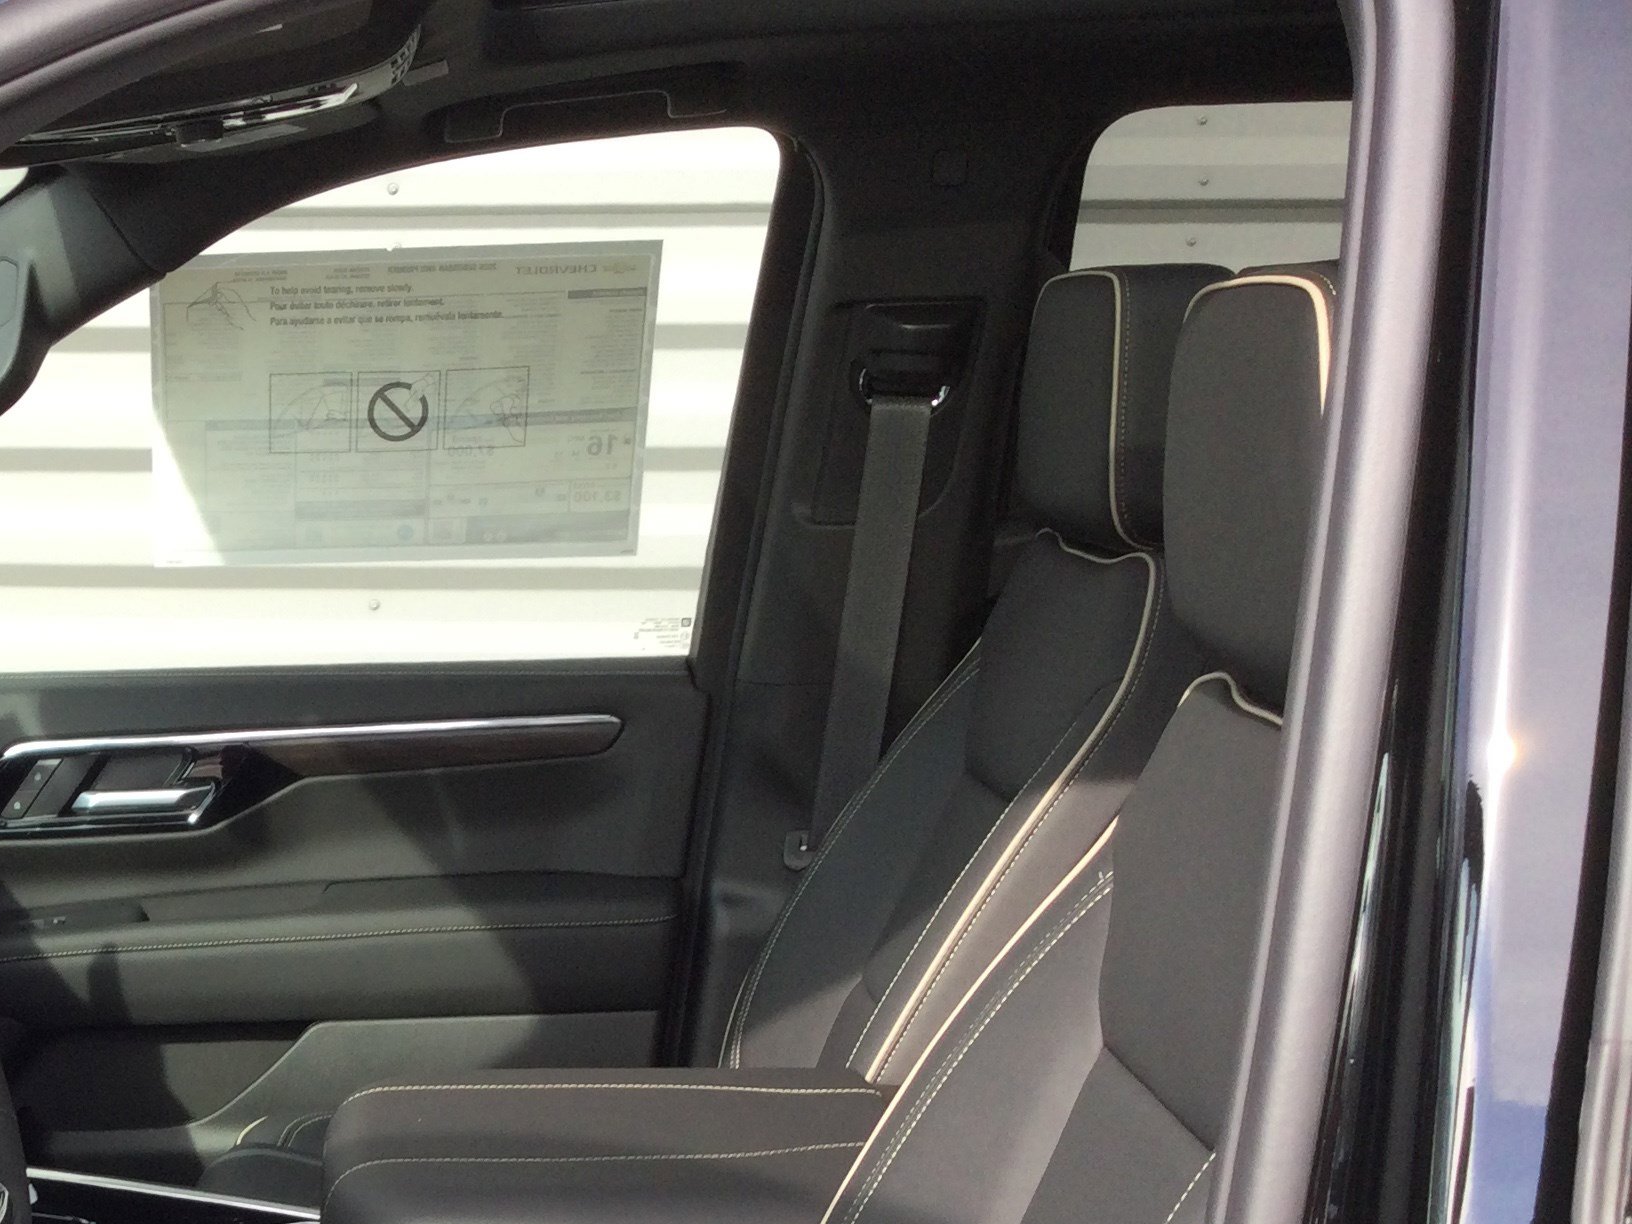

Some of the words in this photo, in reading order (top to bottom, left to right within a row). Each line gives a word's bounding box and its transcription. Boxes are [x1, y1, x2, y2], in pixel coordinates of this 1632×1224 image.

[270, 286, 280, 295] To
[281, 286, 298, 296] help
[301, 285, 321, 295] avoid
[355, 285, 385, 293] remove
[270, 301, 287, 311] Pour
[270, 316, 288, 326] Para
[334, 315, 355, 325] evitar
